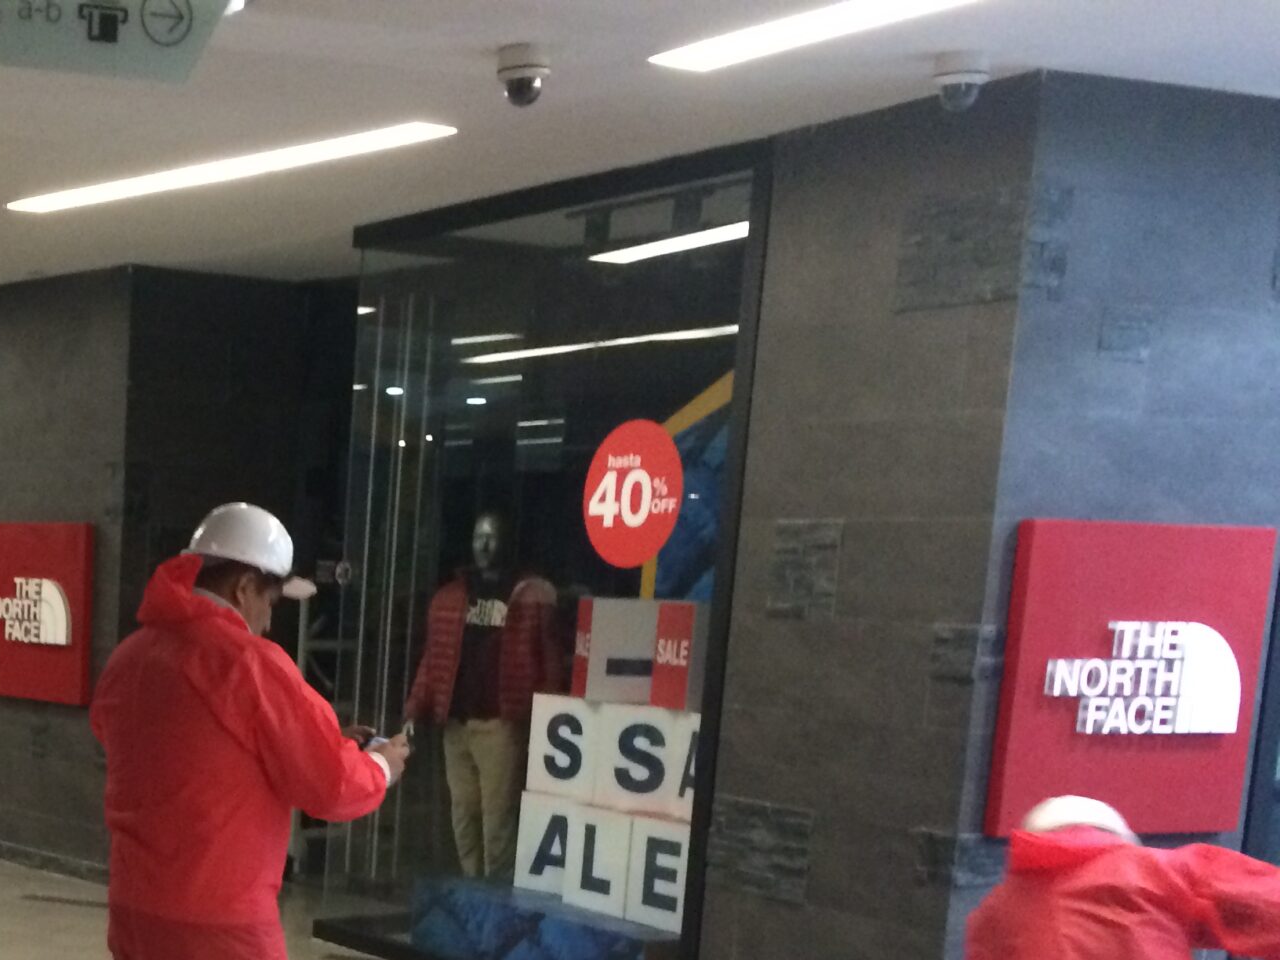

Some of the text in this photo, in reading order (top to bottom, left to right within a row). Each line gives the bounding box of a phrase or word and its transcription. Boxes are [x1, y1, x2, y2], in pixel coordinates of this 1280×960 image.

[607, 453, 642, 469] hasta
[651, 498, 678, 514] OFF
[14, 577, 42, 597] THE
[4, 619, 41, 643] FACE
[1108, 620, 1185, 659] THE
[656, 639, 690, 667] SALE
[1043, 658, 1182, 697] NORTH
[1076, 696, 1178, 734] FACE
